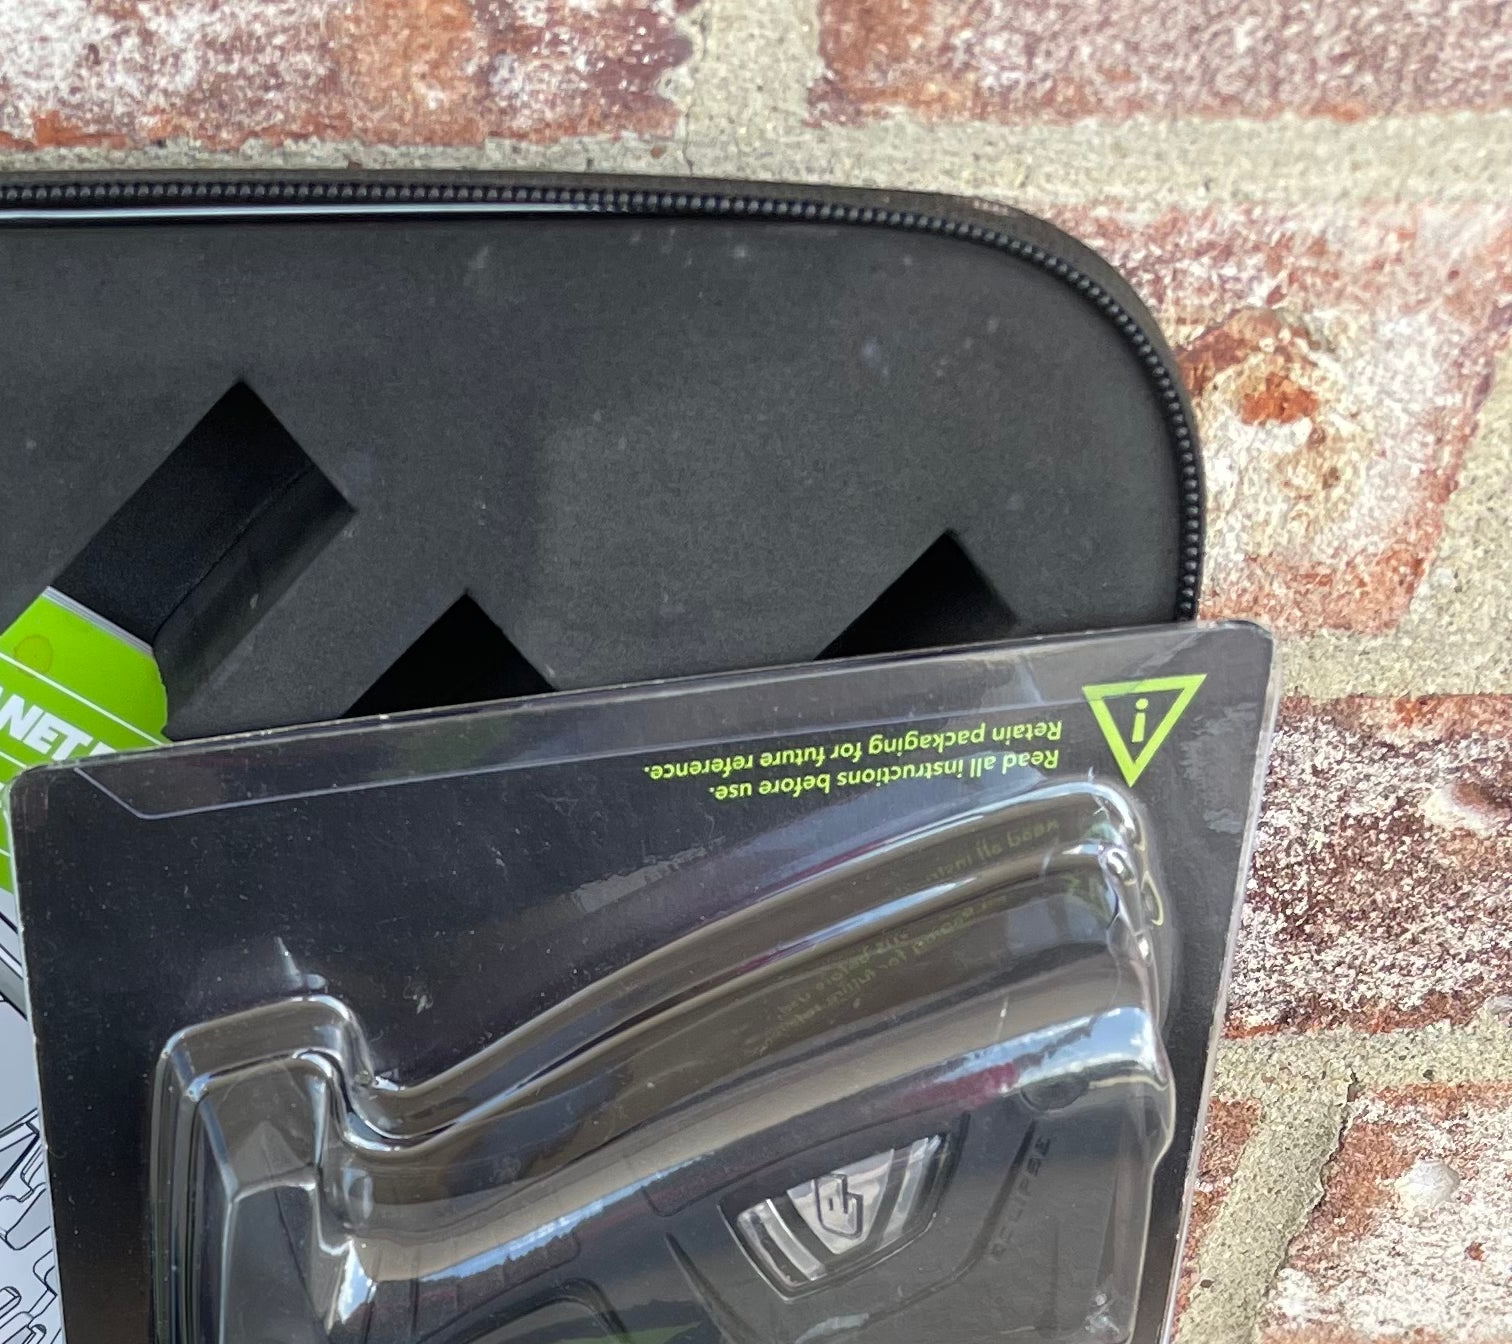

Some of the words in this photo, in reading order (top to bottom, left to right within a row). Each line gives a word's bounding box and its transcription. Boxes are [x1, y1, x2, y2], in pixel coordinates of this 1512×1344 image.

[868, 722, 986, 756] packaging
[992, 720, 1063, 745] Retain
[759, 746, 825, 767] future
[830, 742, 863, 763] for
[1002, 749, 1059, 775] Read
[643, 754, 754, 780] reference.
[837, 758, 964, 787] instructions
[969, 755, 997, 778] all
[709, 782, 753, 800] use.
[758, 773, 831, 798] before
